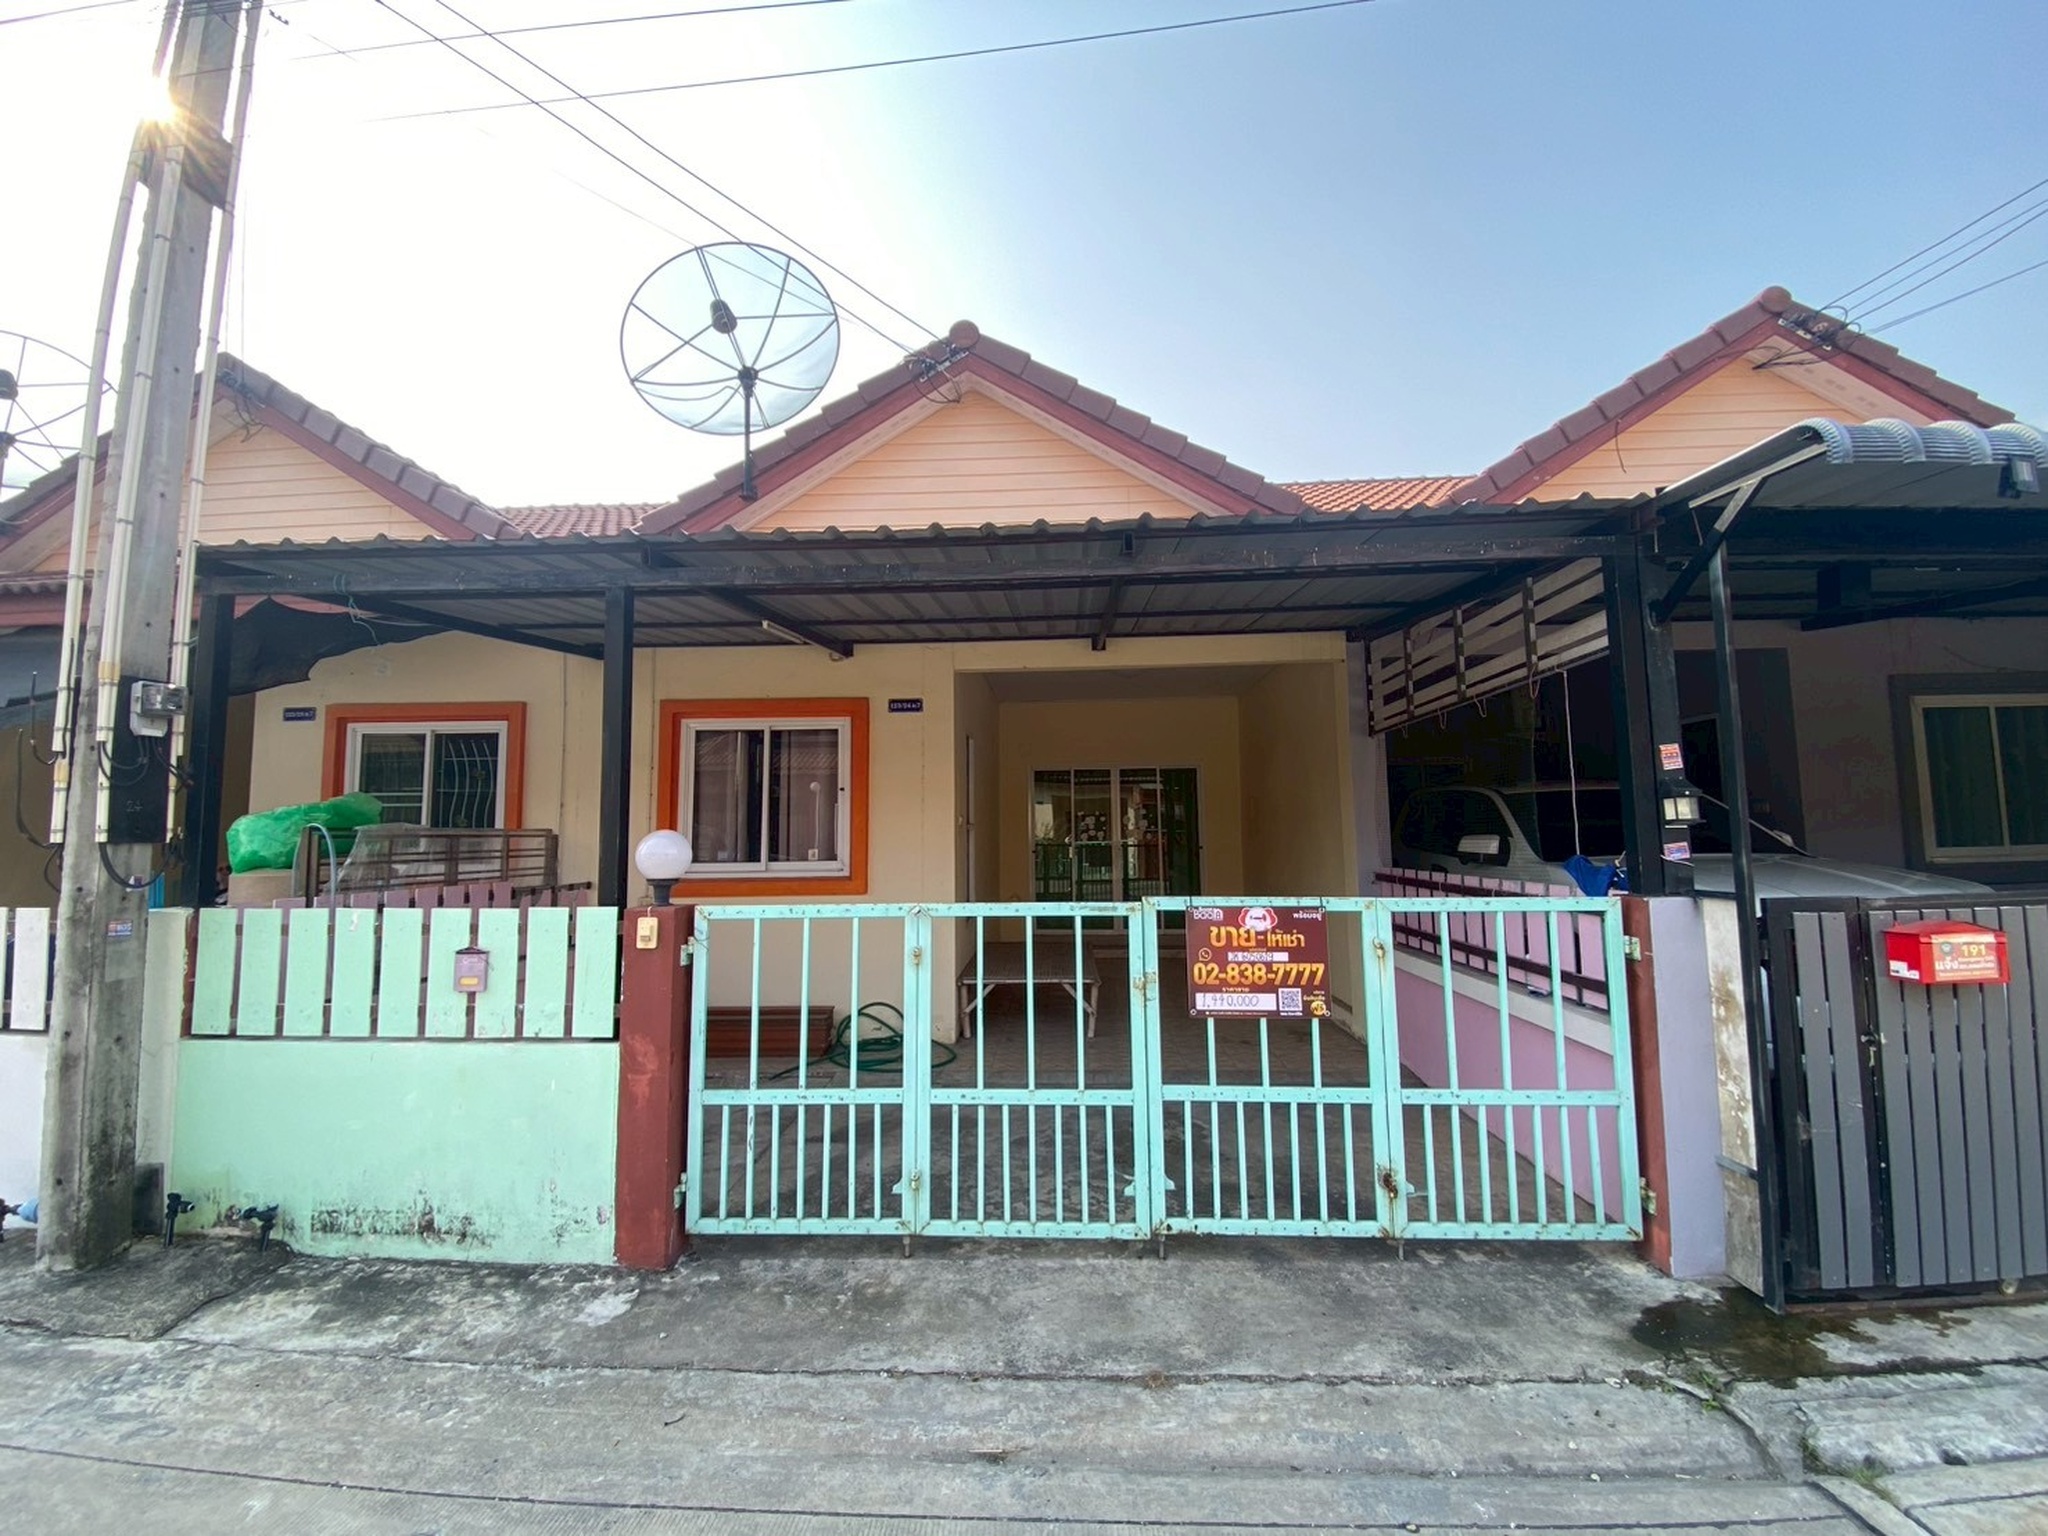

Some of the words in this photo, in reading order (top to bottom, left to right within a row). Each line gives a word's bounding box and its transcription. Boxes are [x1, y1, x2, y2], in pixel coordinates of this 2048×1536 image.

[1961, 944, 1986, 956] 191
[1935, 957, 1959, 970] แจ้ง
[1193, 963, 1325, 985] 02-838-7777
